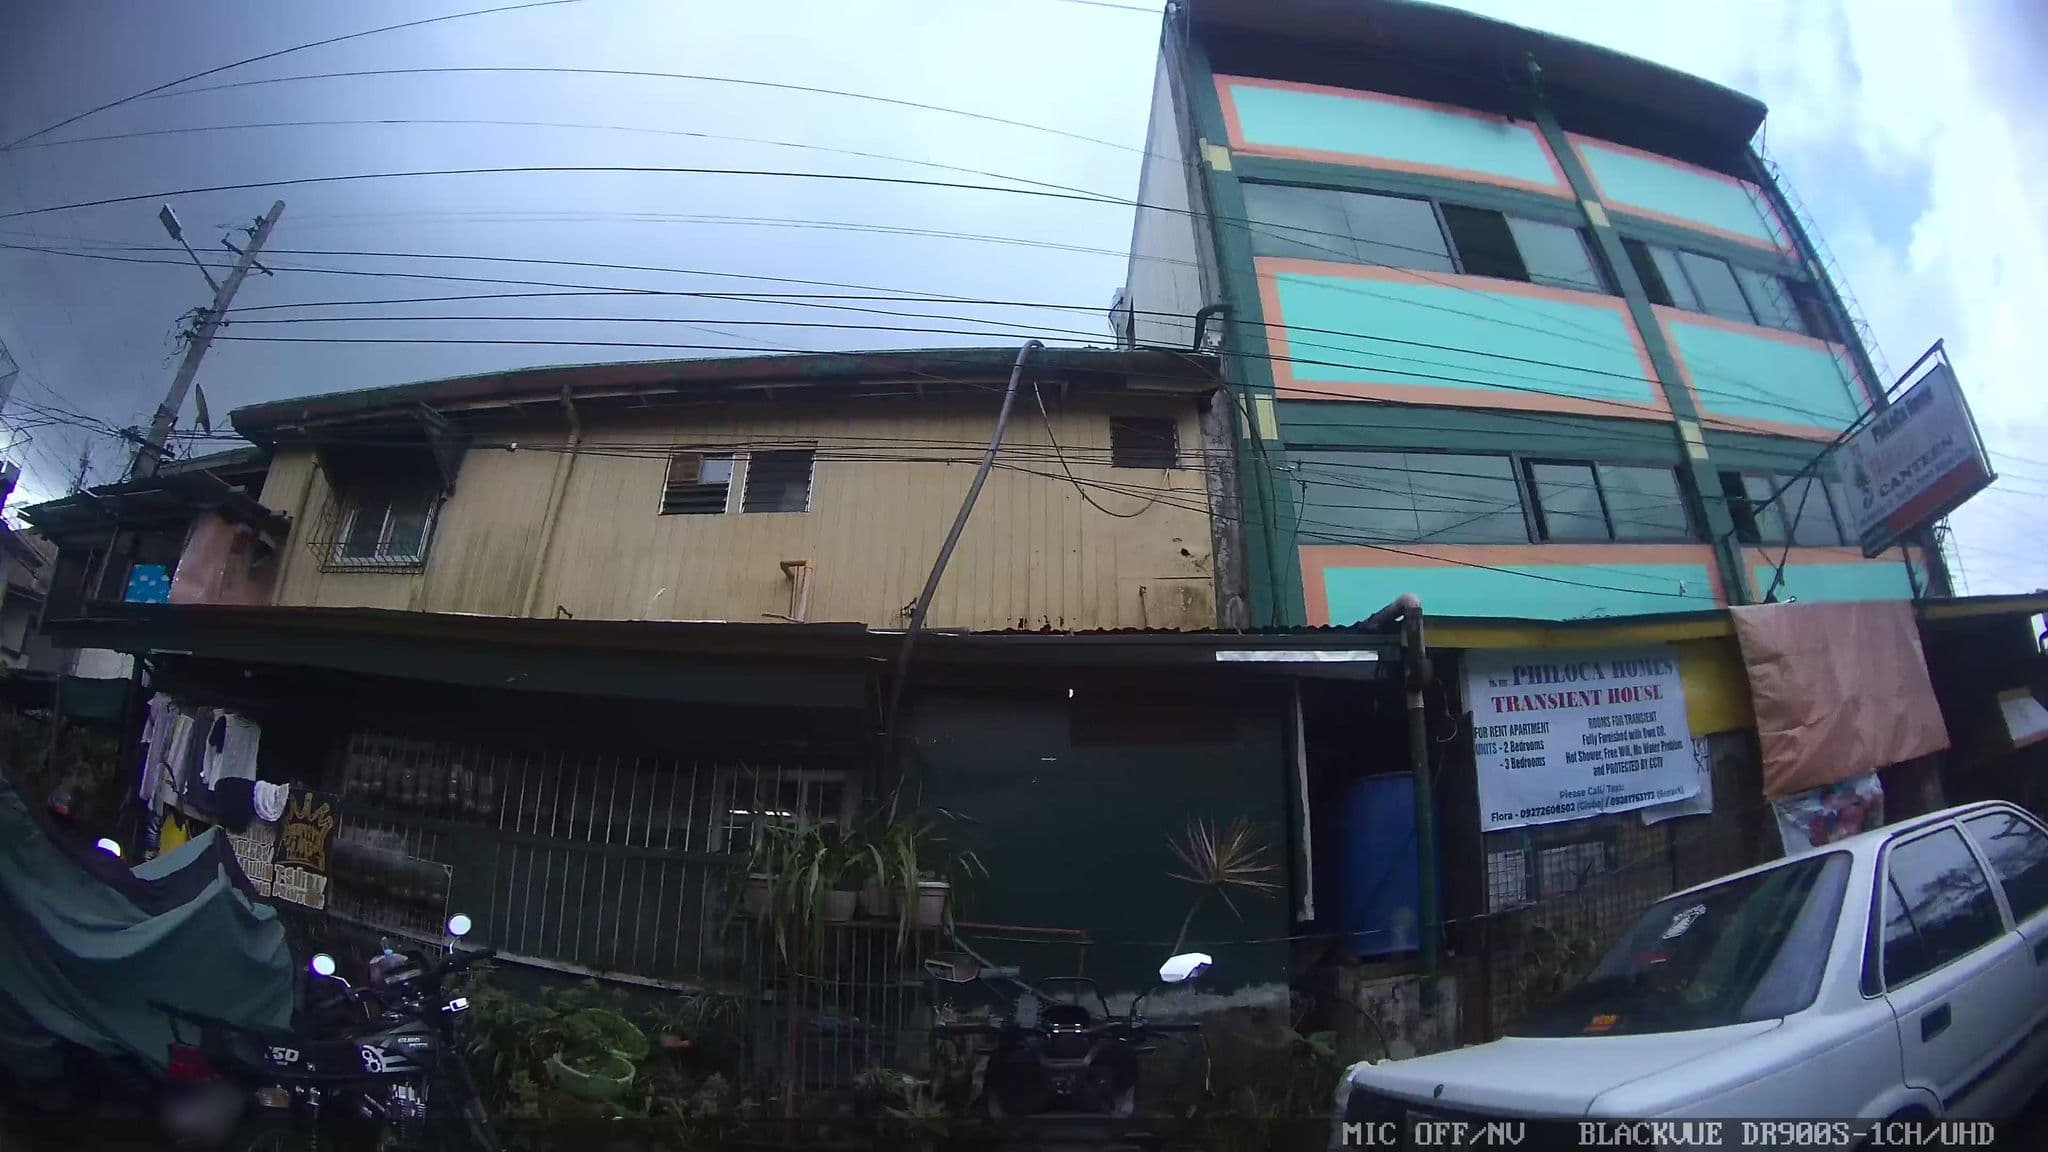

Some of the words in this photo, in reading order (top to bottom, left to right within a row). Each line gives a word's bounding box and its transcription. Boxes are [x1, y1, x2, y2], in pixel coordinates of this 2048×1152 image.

[1513, 661, 1606, 686] PHILOCA
[1611, 656, 1673, 679] HOMES
[1491, 689, 1602, 713] TRANSIENT
[1607, 684, 1664, 705] HOUSE
[1588, 717, 1611, 729] ROOMS
[1612, 715, 1624, 726] FOR
[1624, 711, 1657, 725] TRANSIENT
[1474, 726, 1488, 739] FOR
[1489, 725, 1508, 738] RENT
[1509, 722, 1550, 737] APARTMENT
[1582, 734, 1597, 746] Fully
[1598, 729, 1628, 744] Furnished
[1628, 729, 1642, 740] with
[1642, 727, 1656, 738] Own
[1475, 742, 1497, 755] UNITS
[1503, 742, 1509, 754] 2
[1510, 740, 1545, 753] Bedrooms
[1566, 751, 1577, 764] Hot
[1604, 747, 1618, 759] Free
[1633, 744, 1642, 755] No
[1642, 742, 1660, 754] Water
[1660, 739, 1684, 752] Problem
[1504, 758, 1510, 770] 3
[1510, 756, 1546, 769] Bedrooms
[1593, 766, 1604, 777] and
[1605, 759, 1639, 775] PROTECTED
[1640, 758, 1648, 770] BY
[1649, 756, 1663, 769] CCTV
[1560, 787, 1586, 799] Please
[1491, 812, 1513, 822] Flora
